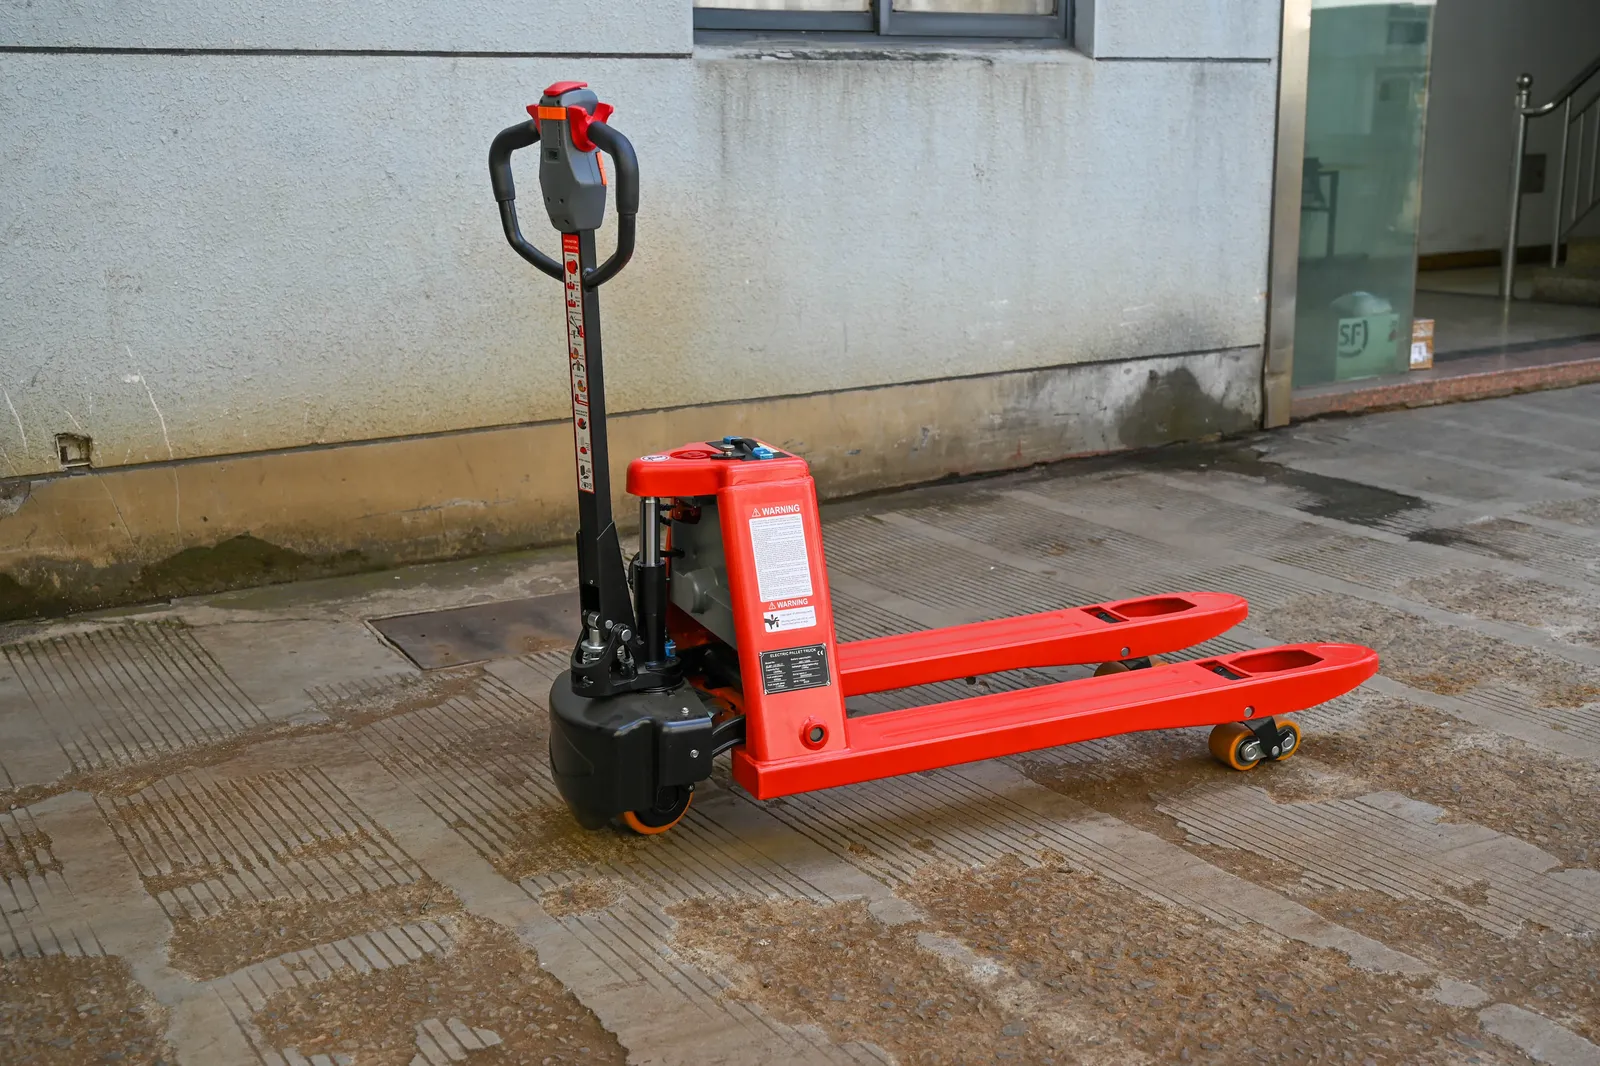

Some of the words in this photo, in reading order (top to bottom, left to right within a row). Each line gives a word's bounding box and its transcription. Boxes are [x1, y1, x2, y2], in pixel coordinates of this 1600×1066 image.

[1340, 324, 1361, 346] SF
[762, 504, 800, 515] WARNING
[777, 598, 808, 608] WARNING
